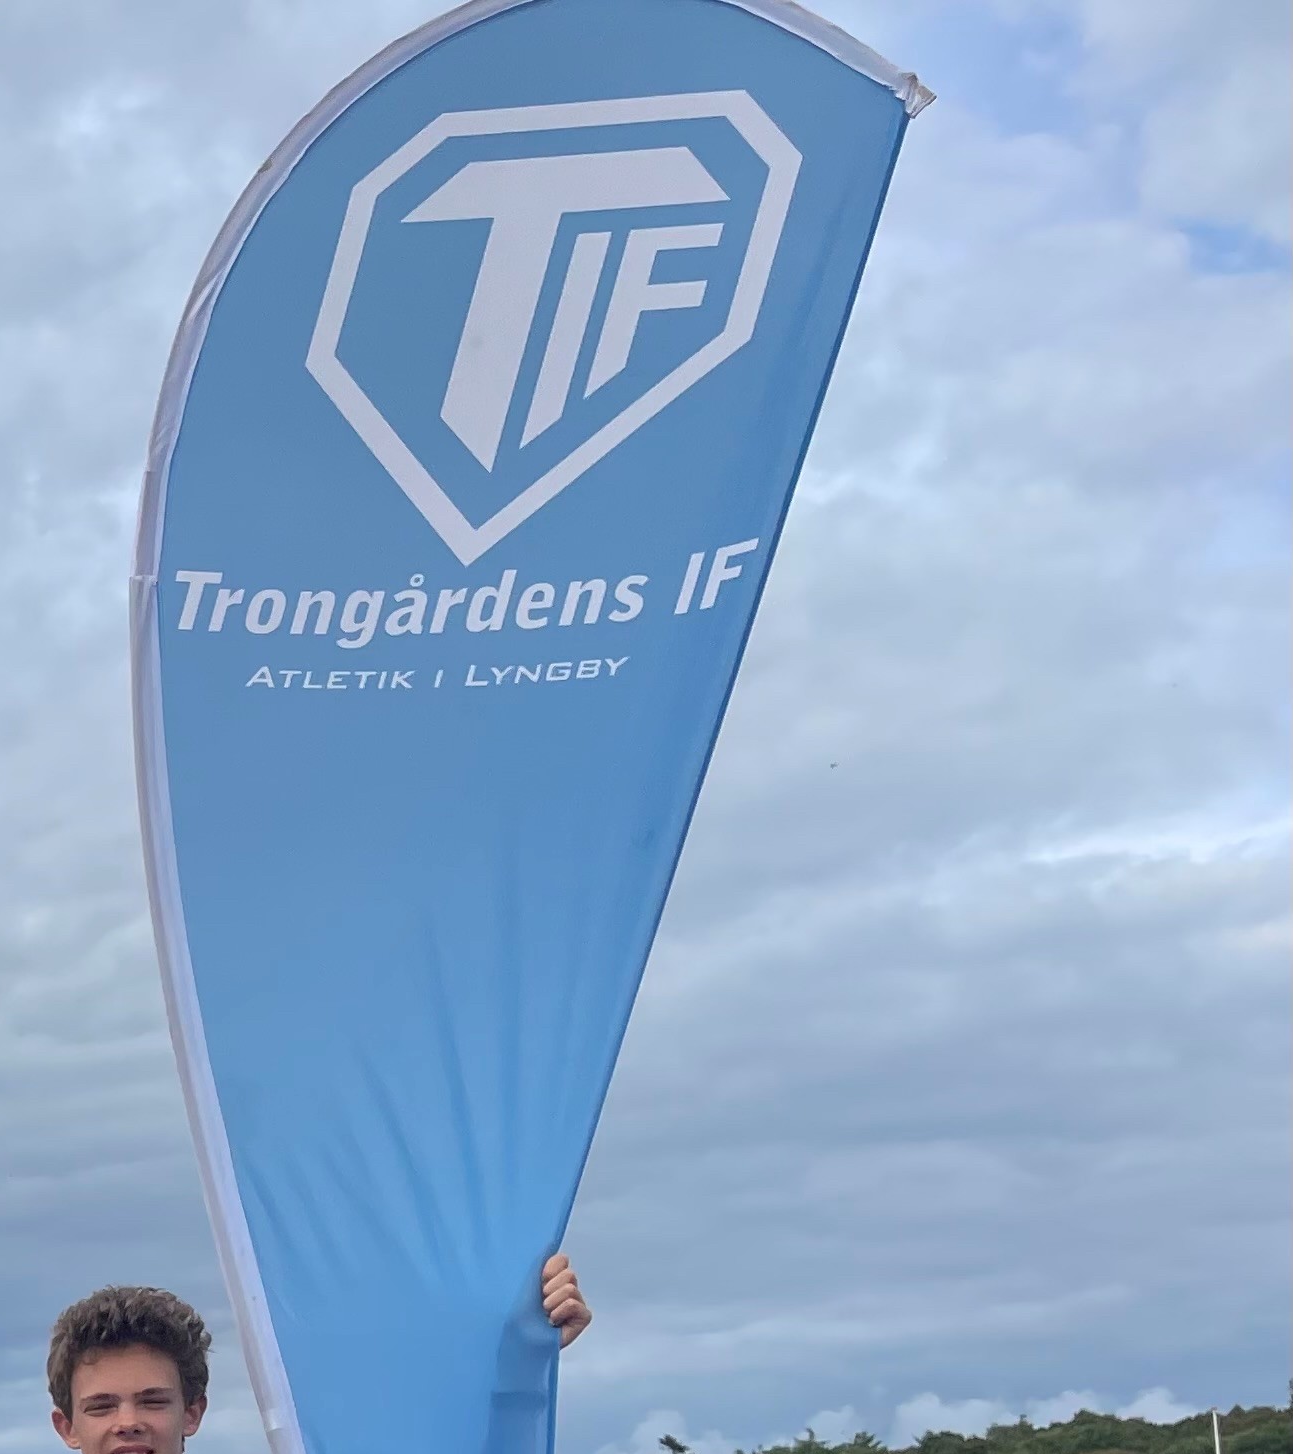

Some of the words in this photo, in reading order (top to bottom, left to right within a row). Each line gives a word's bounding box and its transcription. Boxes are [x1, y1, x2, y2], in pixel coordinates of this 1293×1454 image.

[401, 146, 731, 473] TIF
[175, 568, 650, 650] Trongårdens
[673, 537, 760, 616] IF
[245, 666, 415, 690] ATLETIK
[465, 656, 630, 687] LYNGBY
